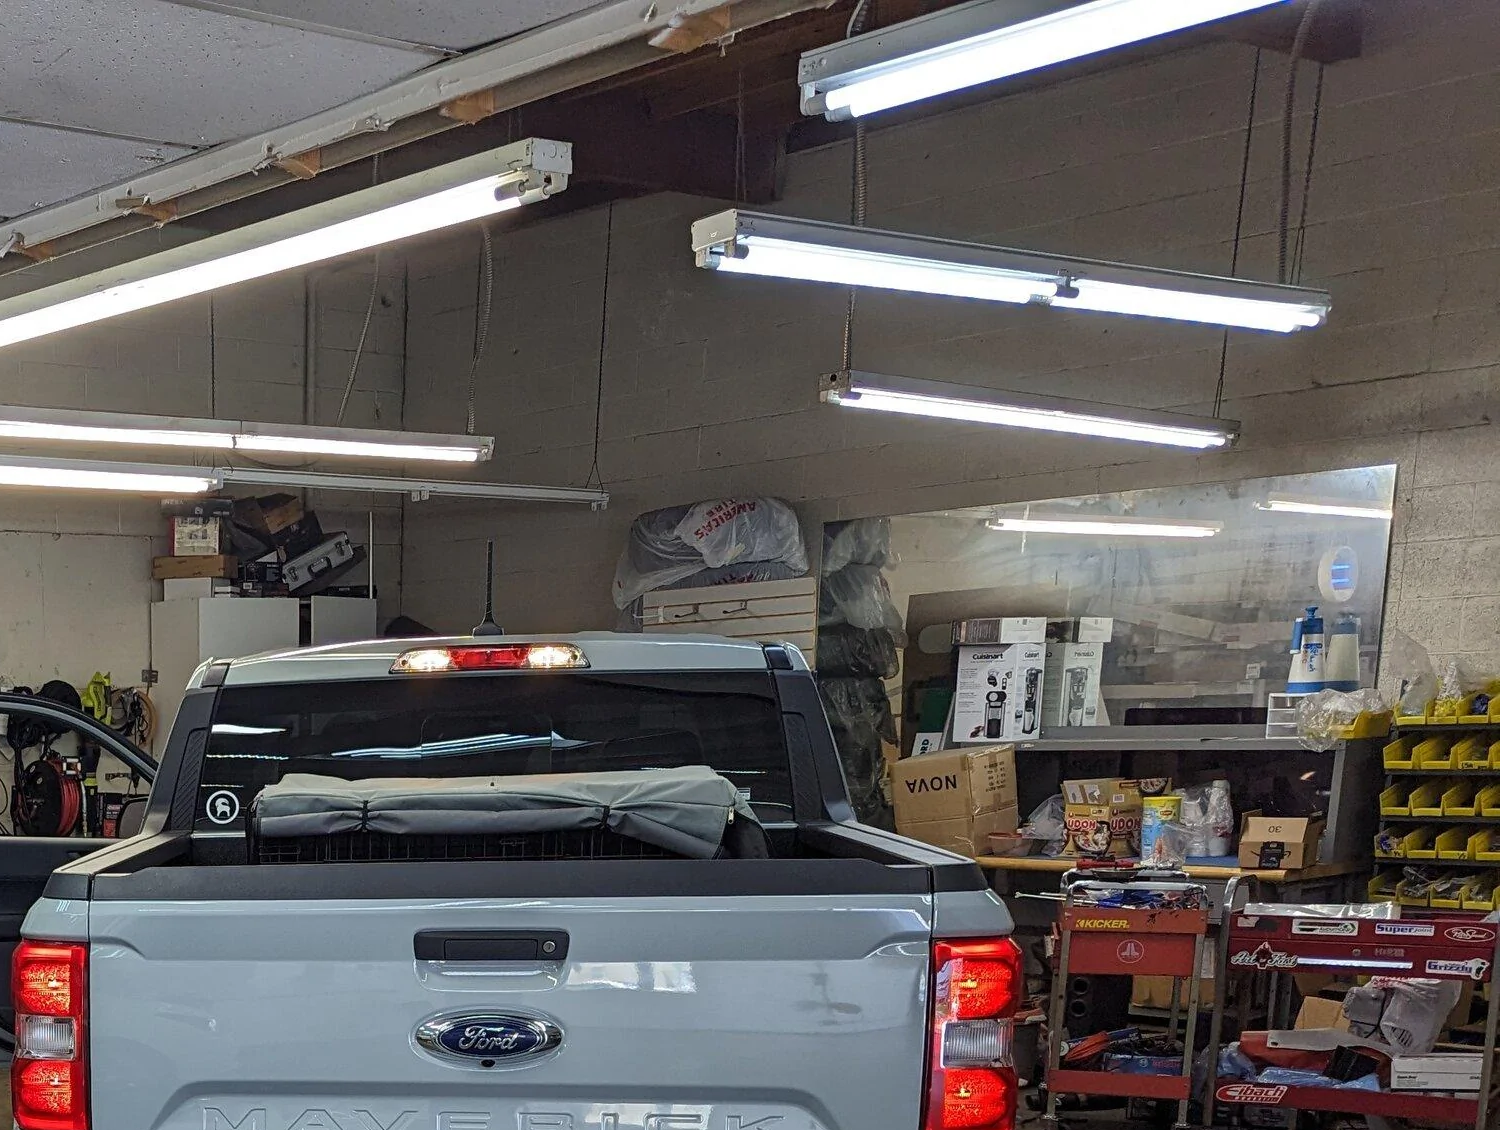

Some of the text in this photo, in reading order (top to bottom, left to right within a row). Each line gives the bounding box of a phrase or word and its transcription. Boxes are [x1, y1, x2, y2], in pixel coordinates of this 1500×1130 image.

[694, 501, 756, 540] AMERICA'S
[905, 774, 957, 794] NOVA
[1067, 820, 1097, 829] UDON
[1111, 819, 1141, 831] UDON
[1084, 919, 1129, 929] KICKER
[1376, 924, 1415, 934] Super
[1427, 961, 1473, 974] Grizzly
[458, 1025, 519, 1050] Ford
